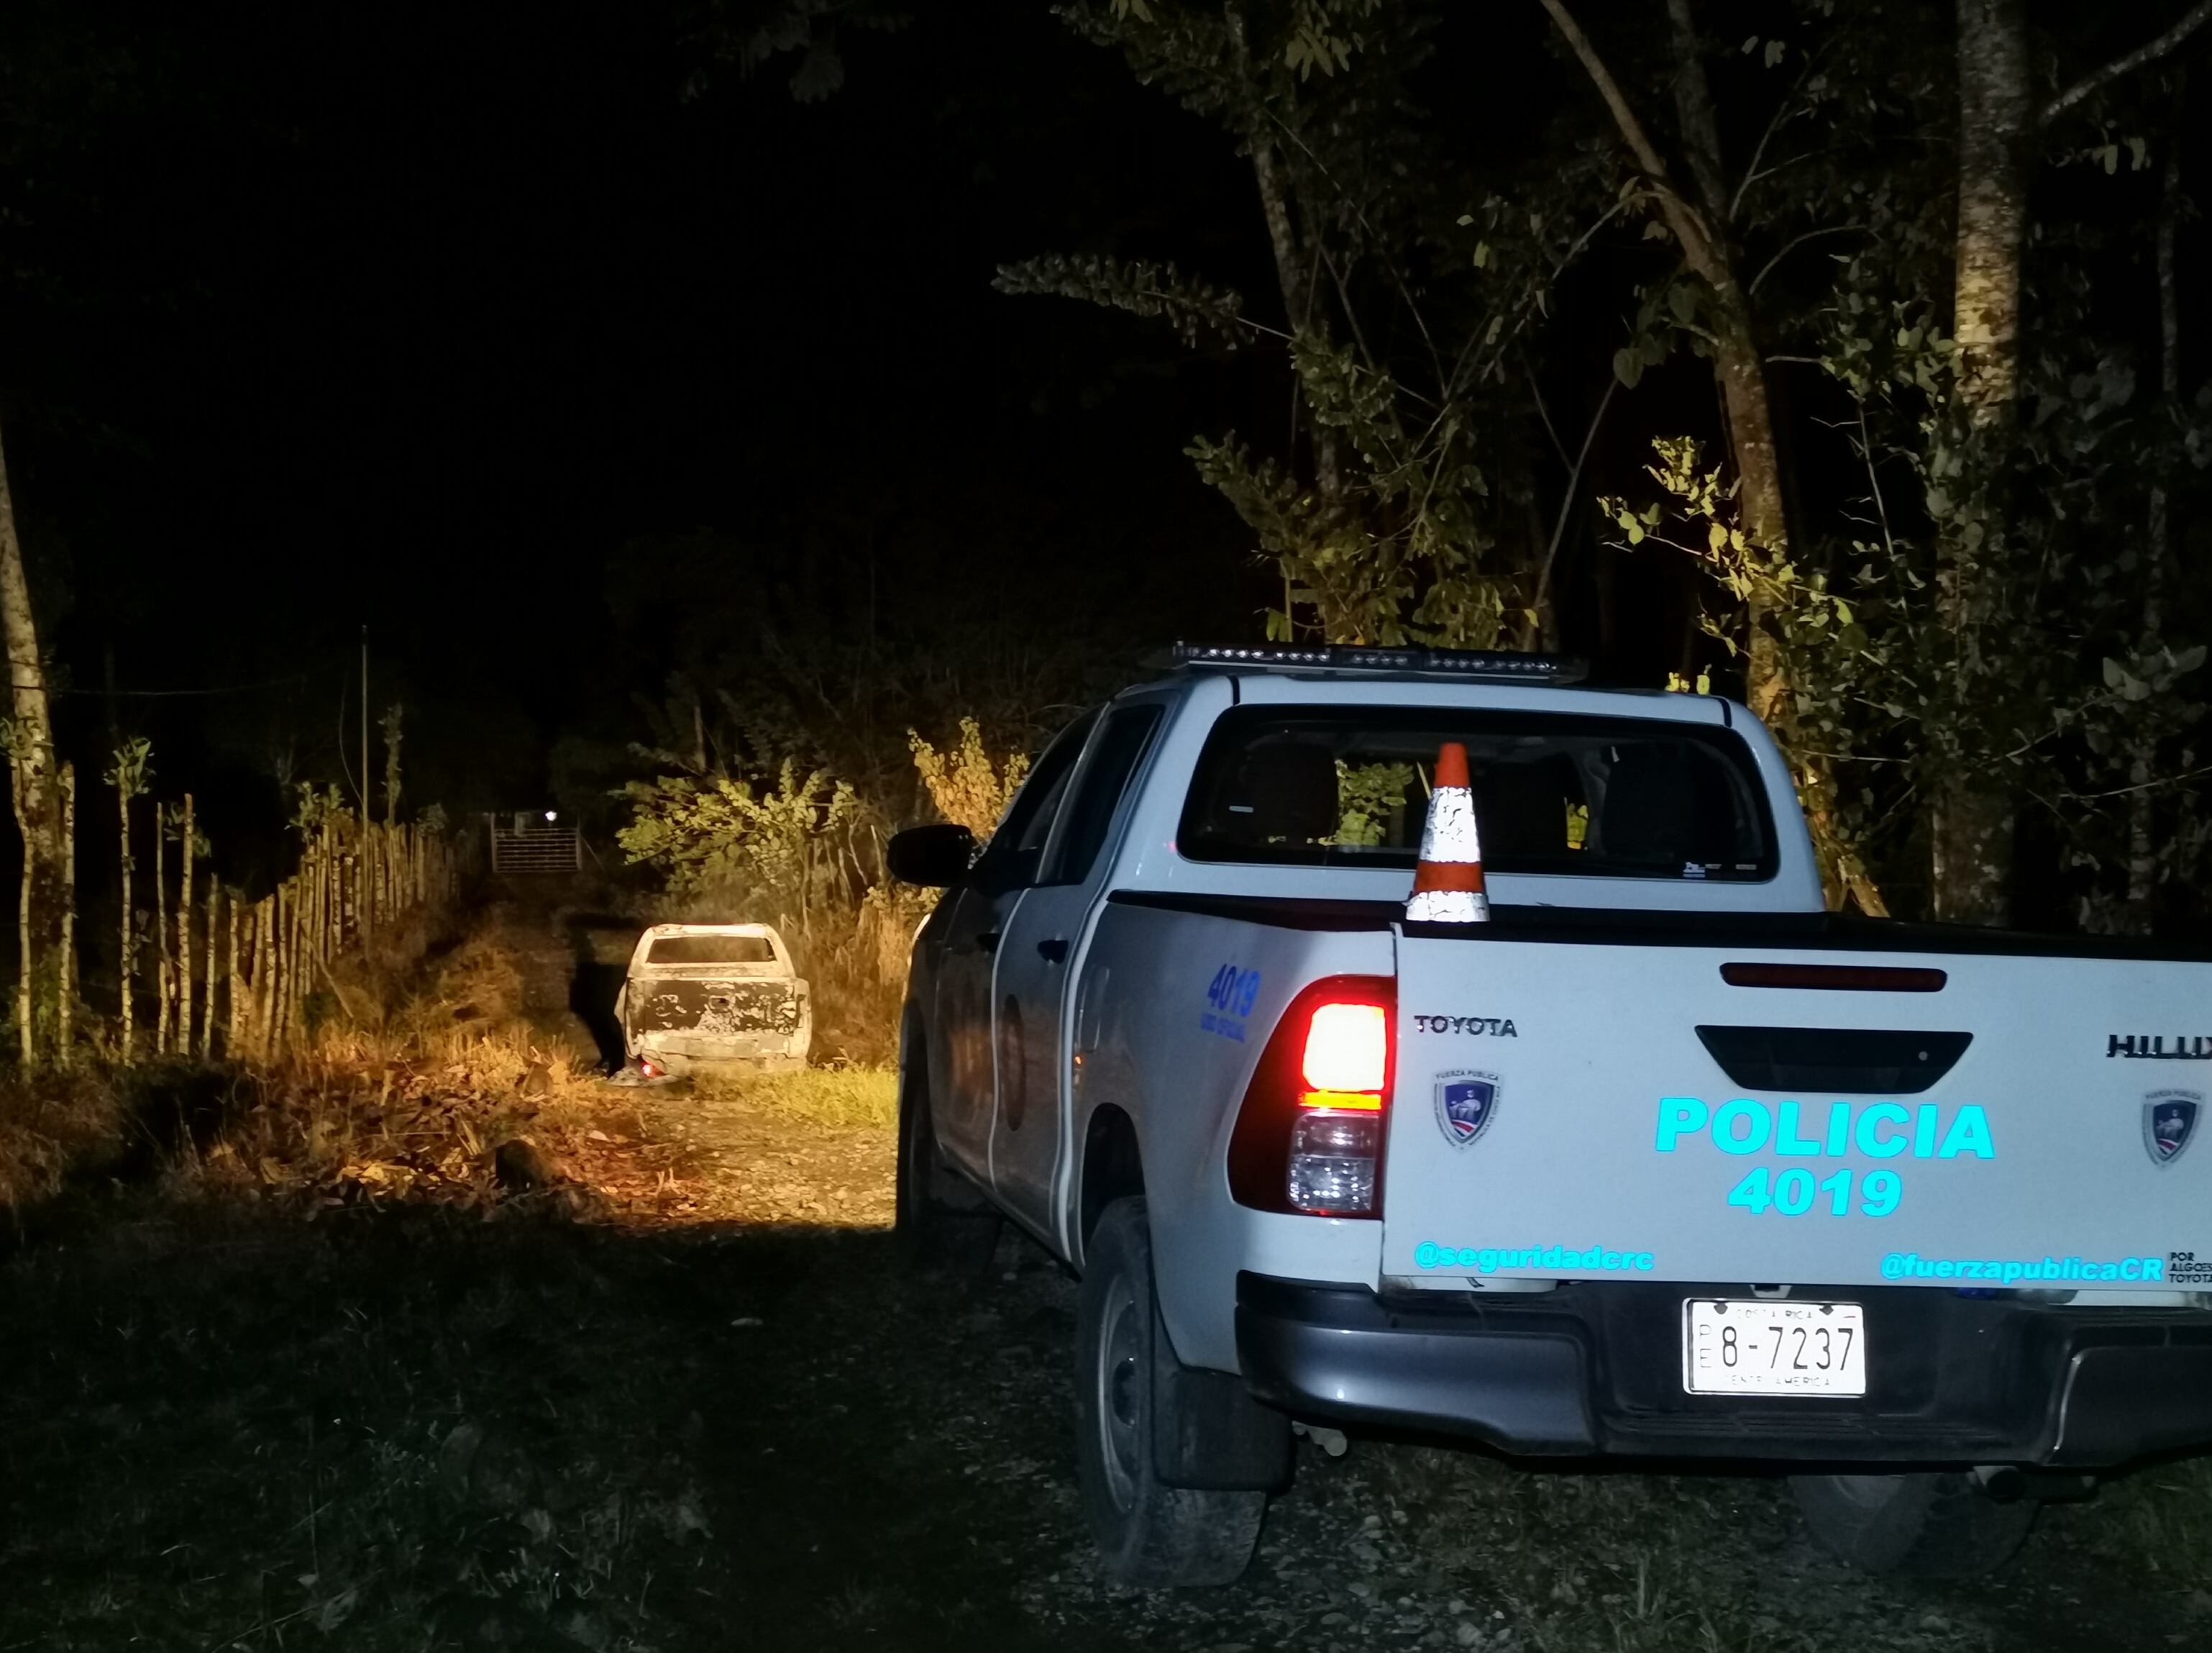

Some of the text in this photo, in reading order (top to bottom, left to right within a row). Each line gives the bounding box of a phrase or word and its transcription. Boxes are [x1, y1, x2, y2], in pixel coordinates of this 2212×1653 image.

[1207, 963, 1261, 1018] 4019
[1413, 1015, 1518, 1037] TOYOTA
[1655, 1096, 1995, 1159] POLICIA
[1727, 1167, 1902, 1217] 4019
[1414, 1241, 1654, 1273] @seguridadcrc
[1880, 1252, 2164, 1284] @fuerzapublicaCR
[2170, 1252, 2195, 1262] POR
[1722, 1326, 1854, 1371] 8-7237
